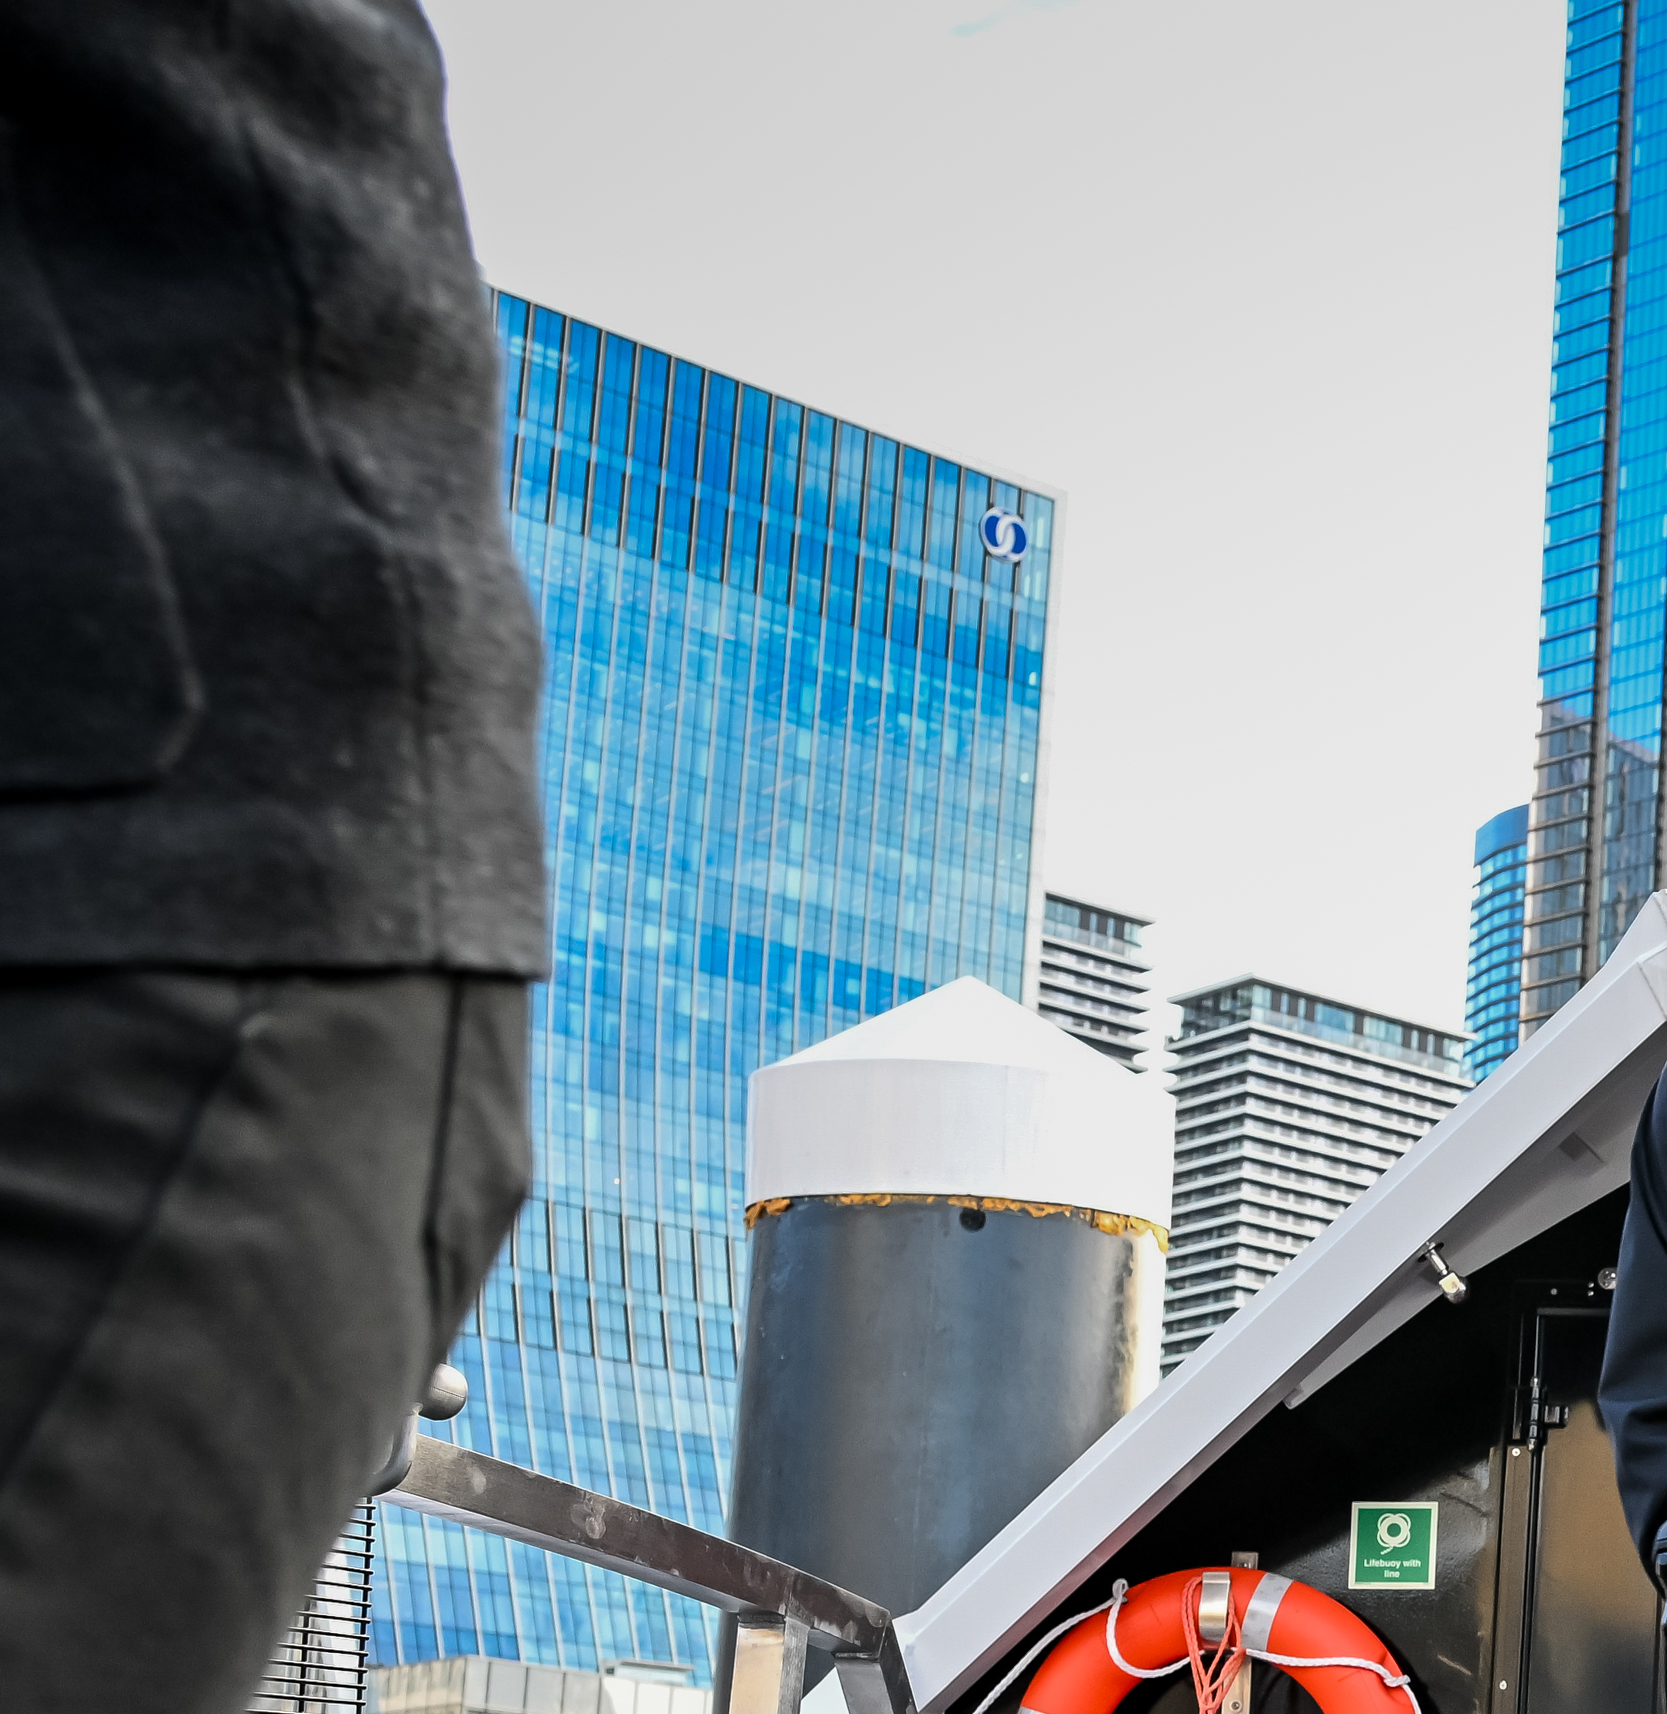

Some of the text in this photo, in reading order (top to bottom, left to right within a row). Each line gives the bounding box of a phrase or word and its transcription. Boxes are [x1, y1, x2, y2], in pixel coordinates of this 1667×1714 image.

[1364, 1559, 1421, 1569] Lifebuoy with
[1384, 1570, 1400, 1578] line
